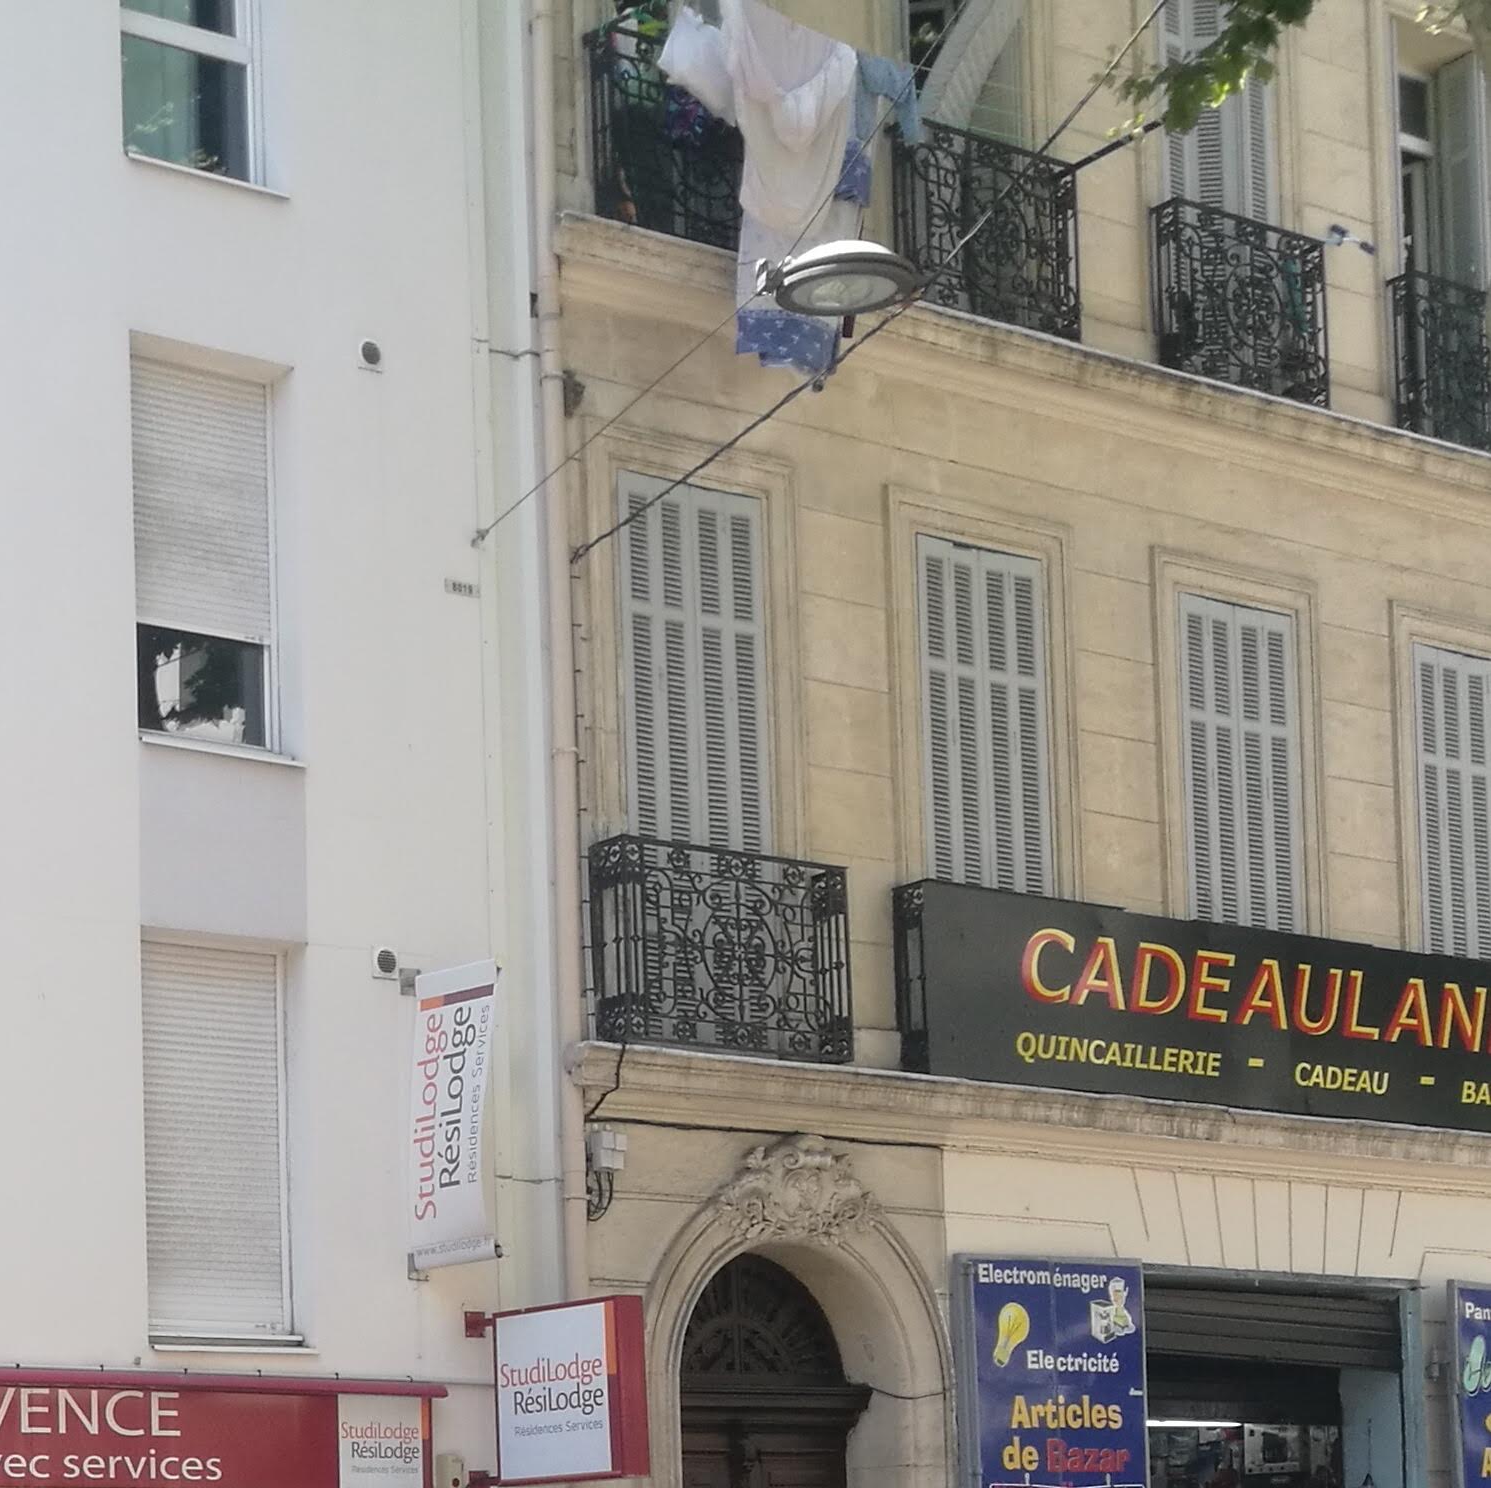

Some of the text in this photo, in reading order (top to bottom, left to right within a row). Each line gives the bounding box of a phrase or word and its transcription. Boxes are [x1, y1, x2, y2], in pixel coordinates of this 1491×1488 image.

[1021, 927, 1491, 1054] CADEAULAN
[1016, 1031, 1222, 1078] QUINCAILLERIE
[1294, 1061, 1389, 1096] CADEAU
[439, 1006, 477, 1188] RésiLodge
[466, 1003, 491, 1184] Résidences Services
[414, 1012, 449, 1221] StudiLodge
[500, 1352, 603, 1388] StudiLodge
[1026, 1349, 1120, 1374] Electricité
[514, 1382, 604, 1416] RésiLodge
[1011, 1395, 1123, 1430] Articles
[341, 1421, 420, 1444] StudiLodge
[565, 1420, 604, 1432] Services
[63, 1449, 222, 1481] services
[351, 1441, 420, 1464] RésiLodge
[1002, 1437, 1131, 1474] de Bazar
